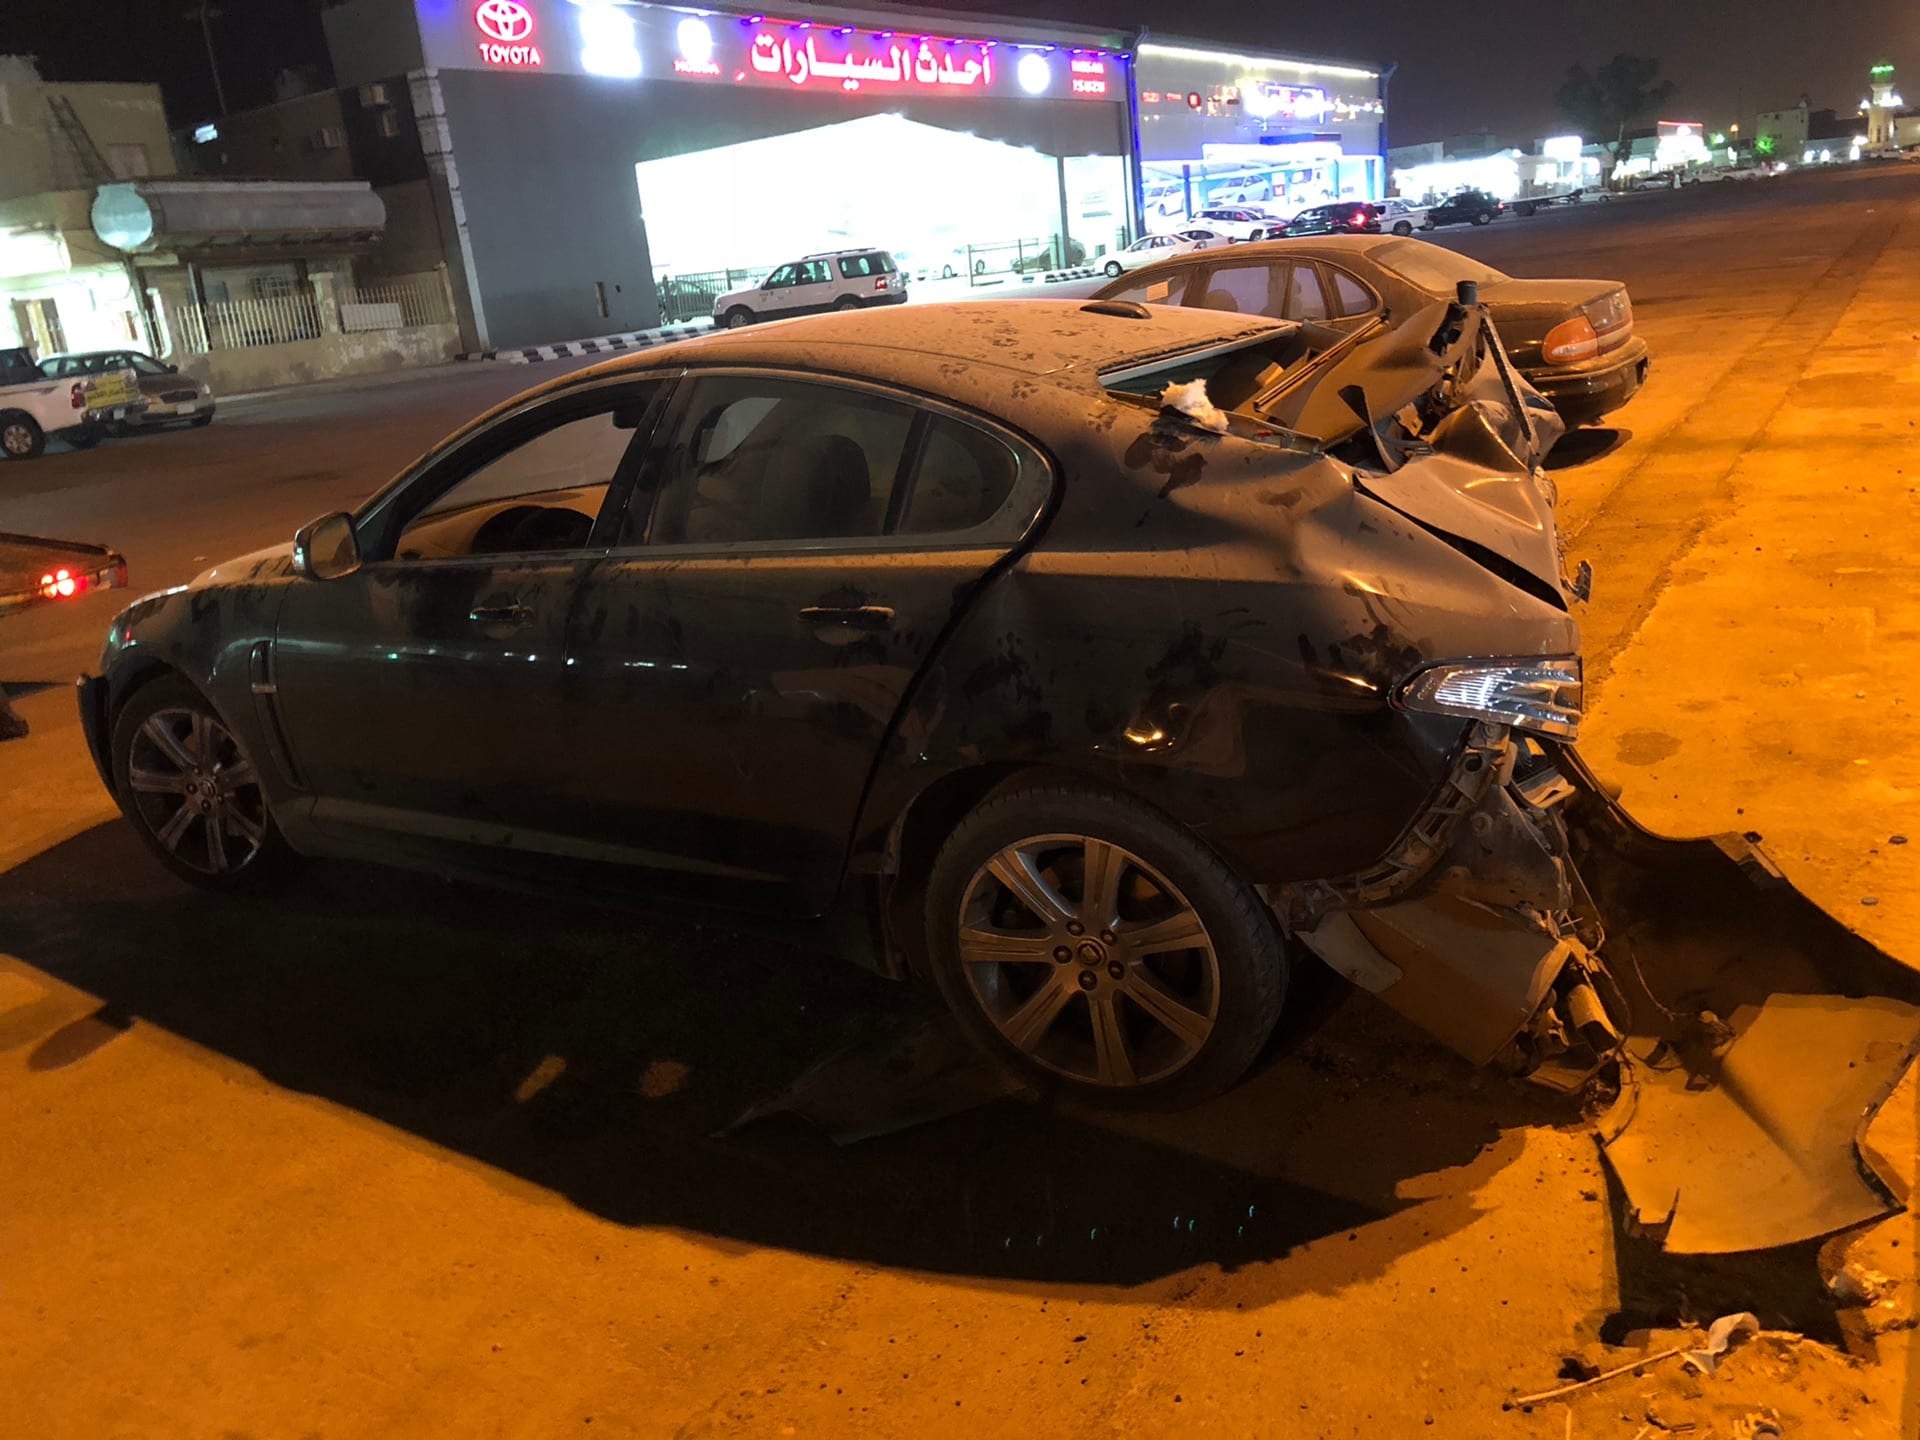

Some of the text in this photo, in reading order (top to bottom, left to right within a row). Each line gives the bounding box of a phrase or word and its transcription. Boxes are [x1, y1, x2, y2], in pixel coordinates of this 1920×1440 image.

[479, 43, 541, 65] TOYOTA
[750, 34, 991, 90] أحدث السيارات
[1072, 79, 1105, 92] ISUZU
